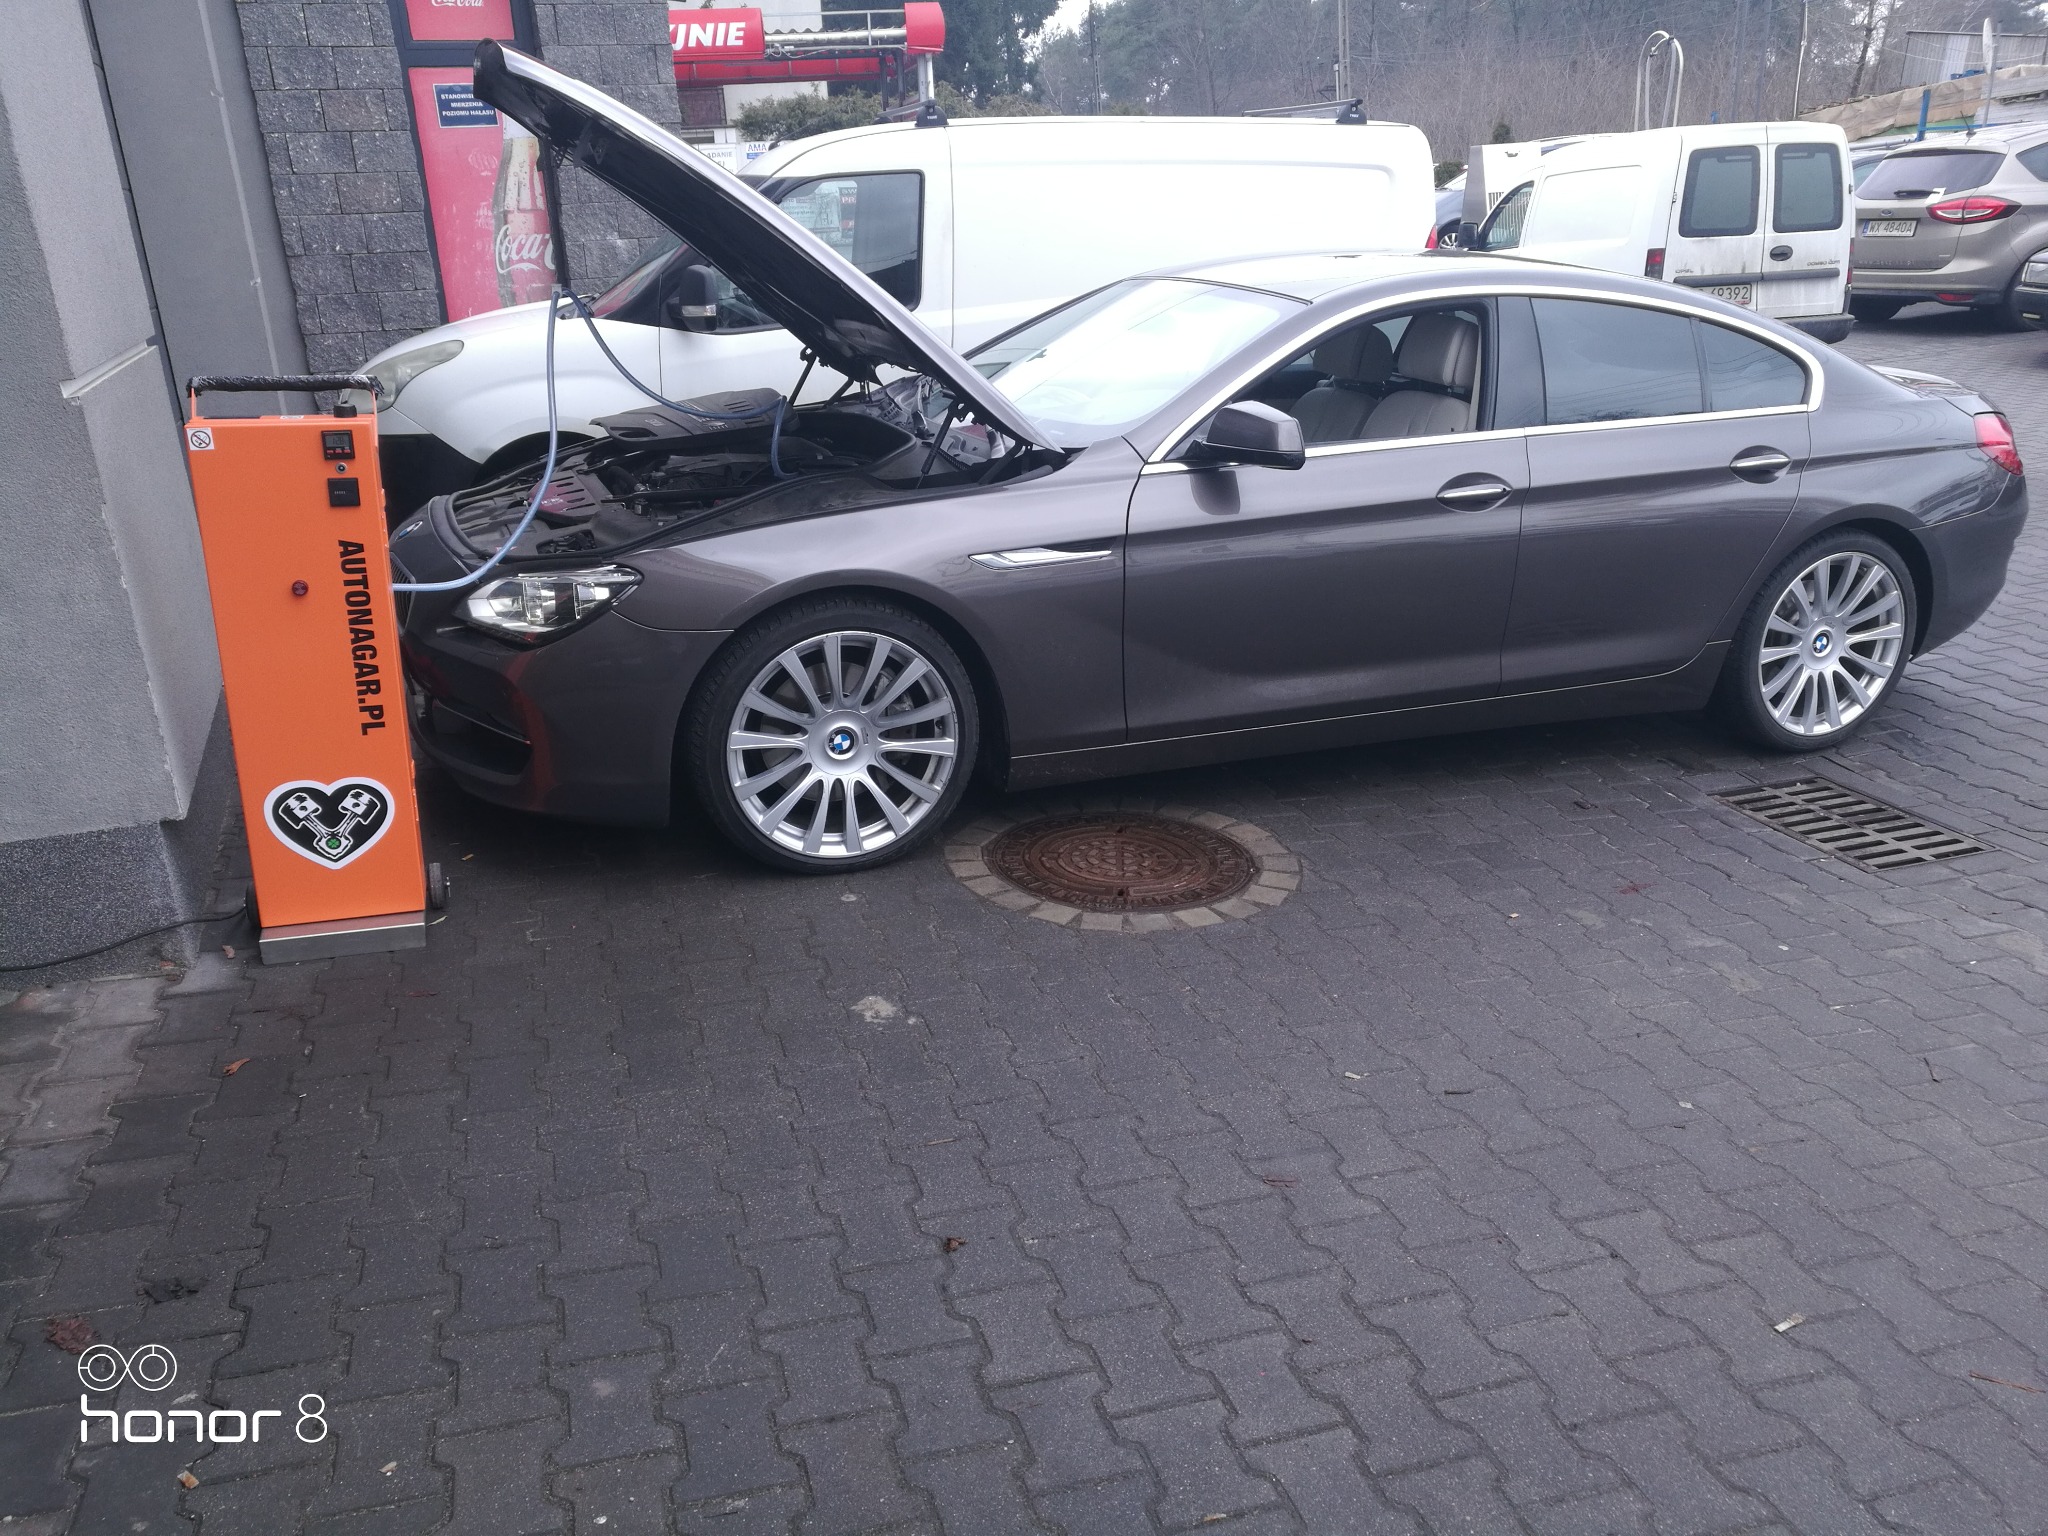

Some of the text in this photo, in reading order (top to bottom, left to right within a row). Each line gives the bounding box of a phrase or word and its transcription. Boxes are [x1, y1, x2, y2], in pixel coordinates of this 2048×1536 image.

[1869, 222, 1912, 232] WX 4840A
[338, 540, 386, 736] AUTONAGAR.PL
